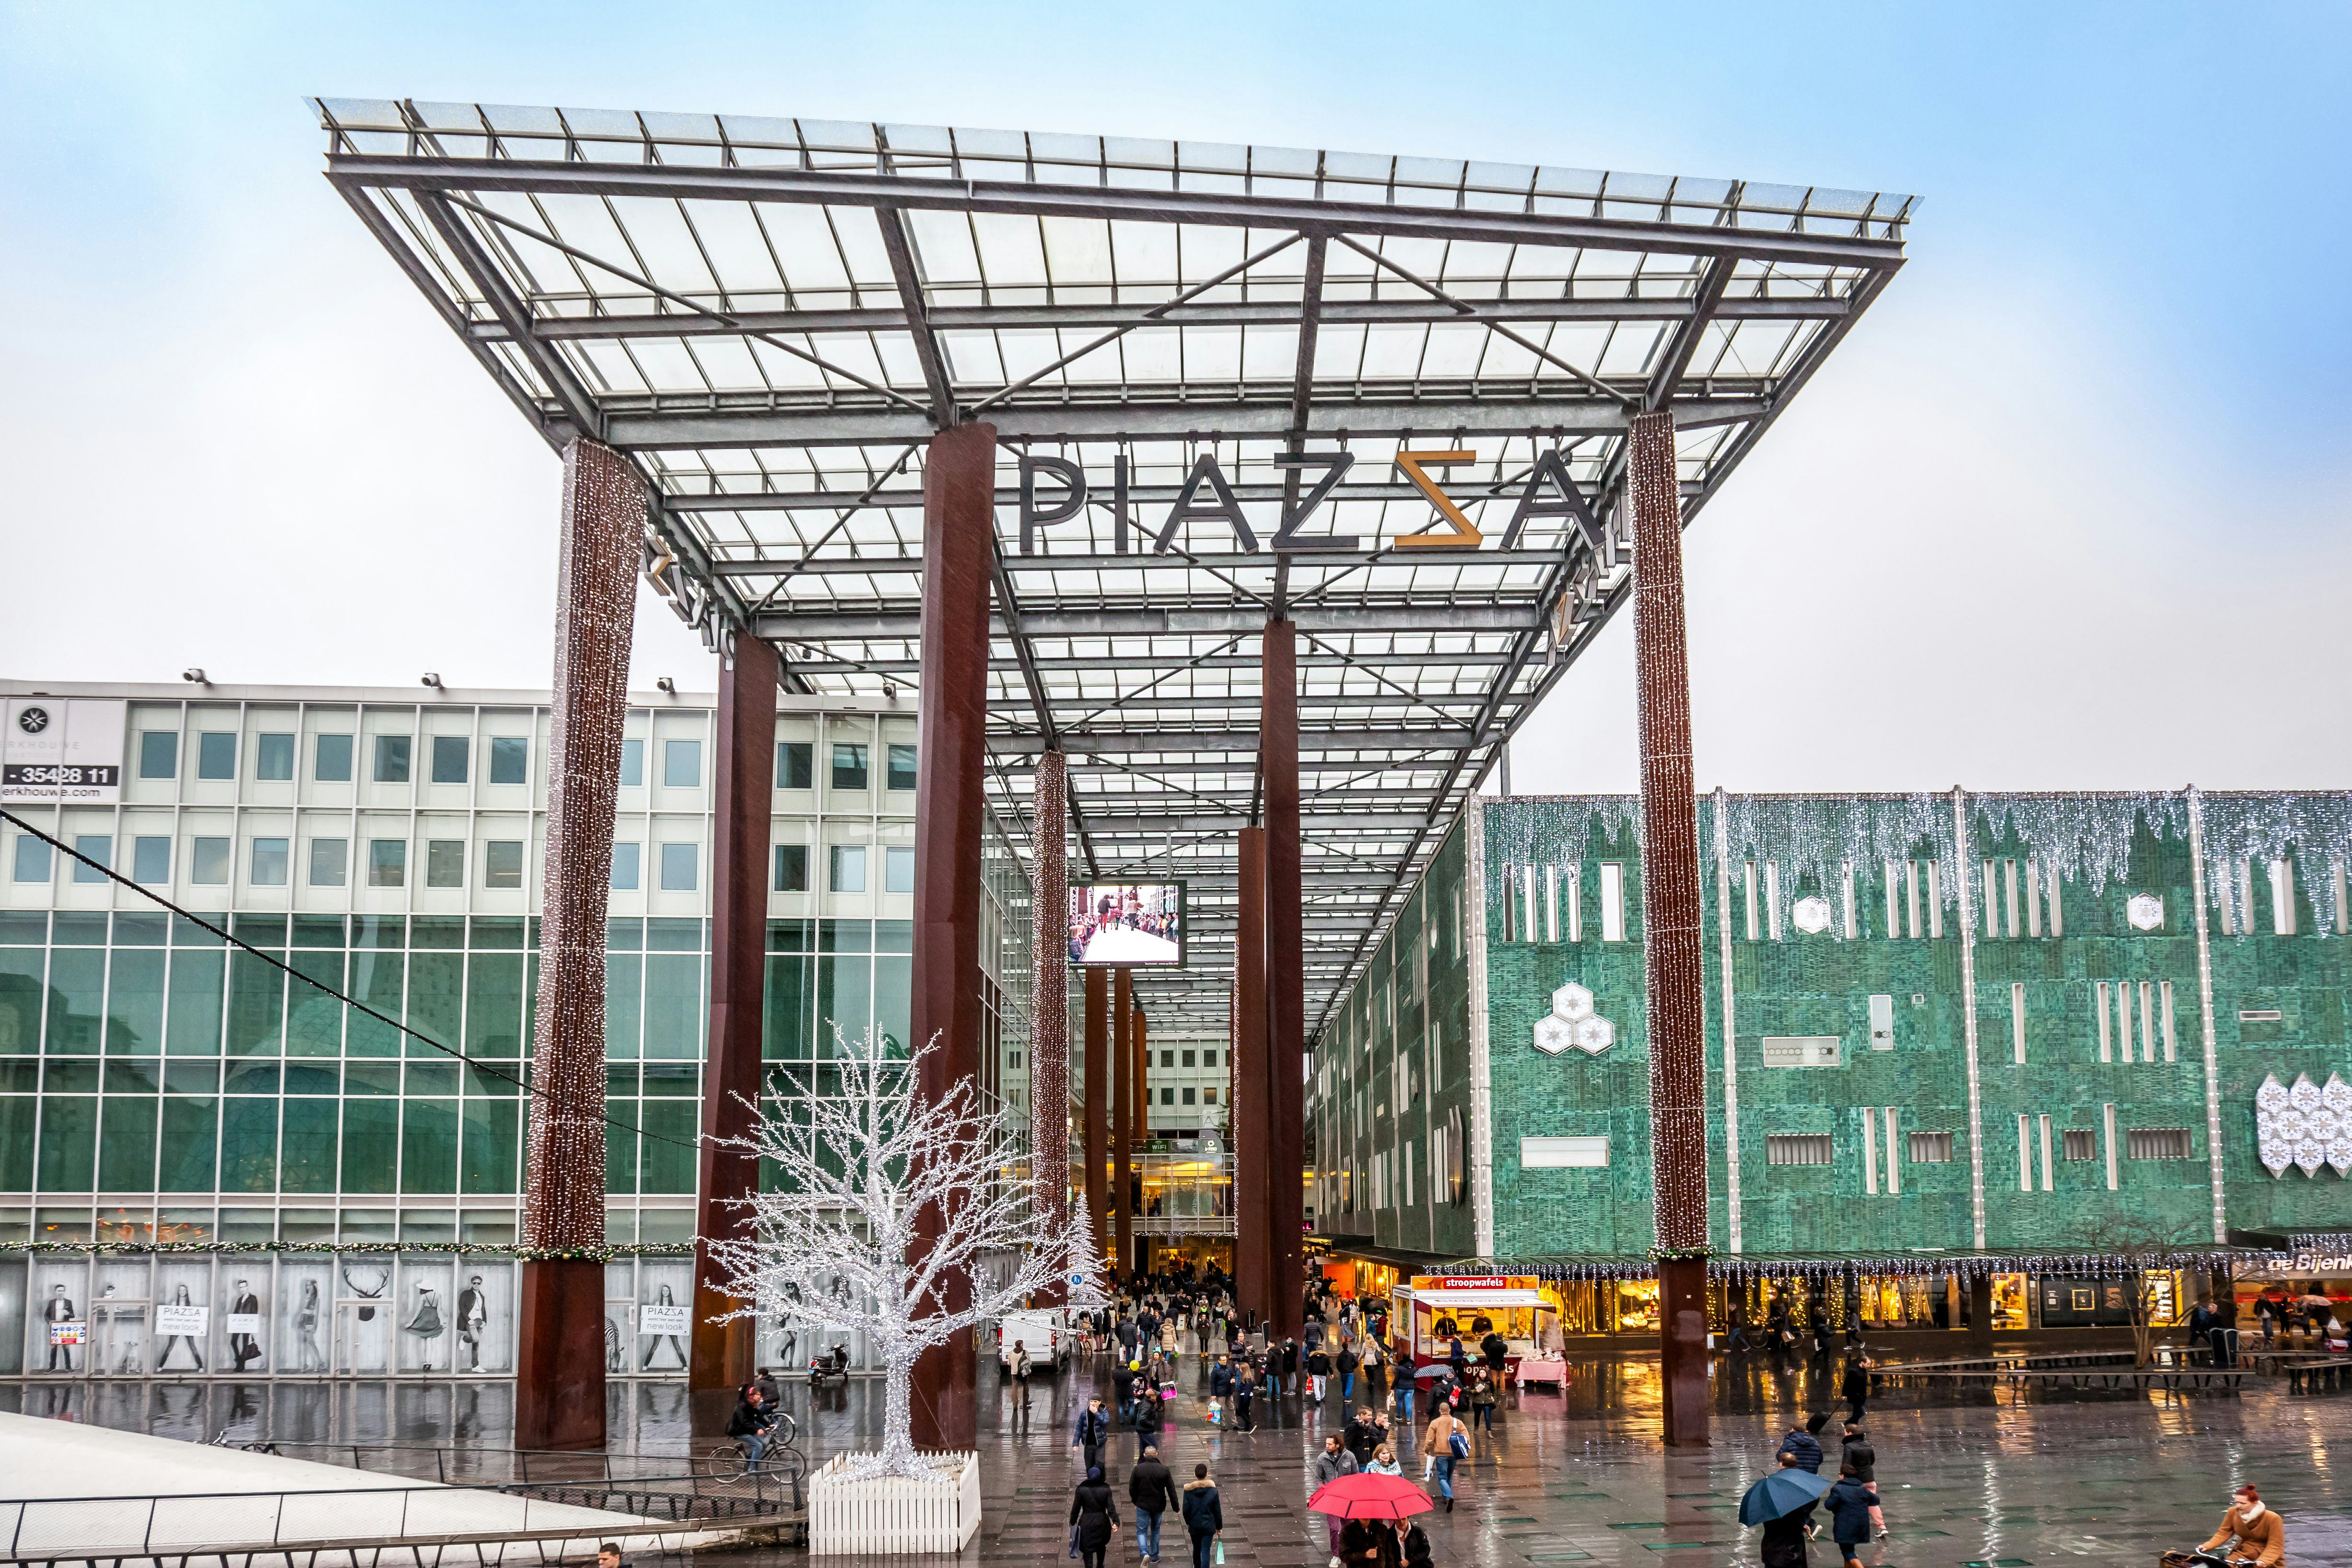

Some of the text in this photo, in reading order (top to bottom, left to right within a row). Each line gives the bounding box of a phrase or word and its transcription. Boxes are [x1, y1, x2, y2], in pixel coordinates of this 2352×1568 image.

[88, 768, 109, 783] 11
[1446, 1277, 1504, 1288] stroopwafels
[648, 1307, 684, 1316] PIAZZA
